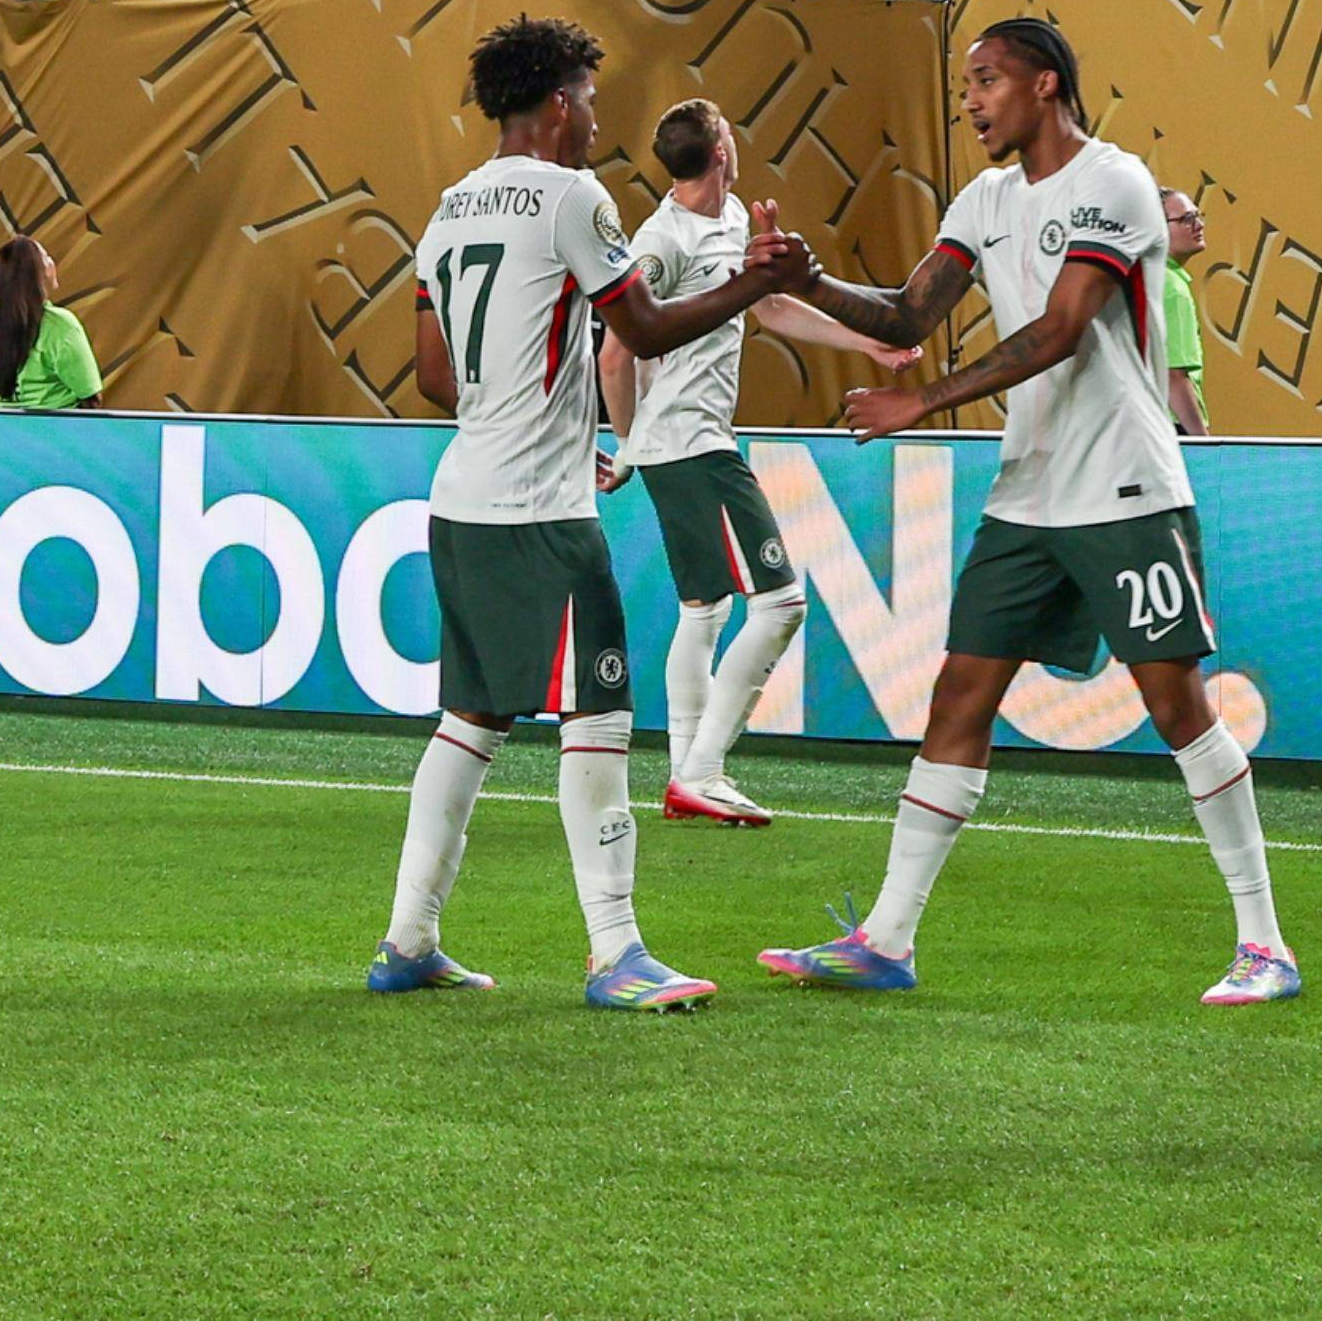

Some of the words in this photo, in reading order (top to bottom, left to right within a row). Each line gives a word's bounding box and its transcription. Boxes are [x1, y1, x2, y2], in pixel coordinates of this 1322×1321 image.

[473, 185, 544, 218] SANTOS
[1070, 206, 1103, 221] LIVE
[1070, 216, 1127, 234] NATION
[435, 242, 506, 386] 17
[1116, 561, 1184, 630] 20
